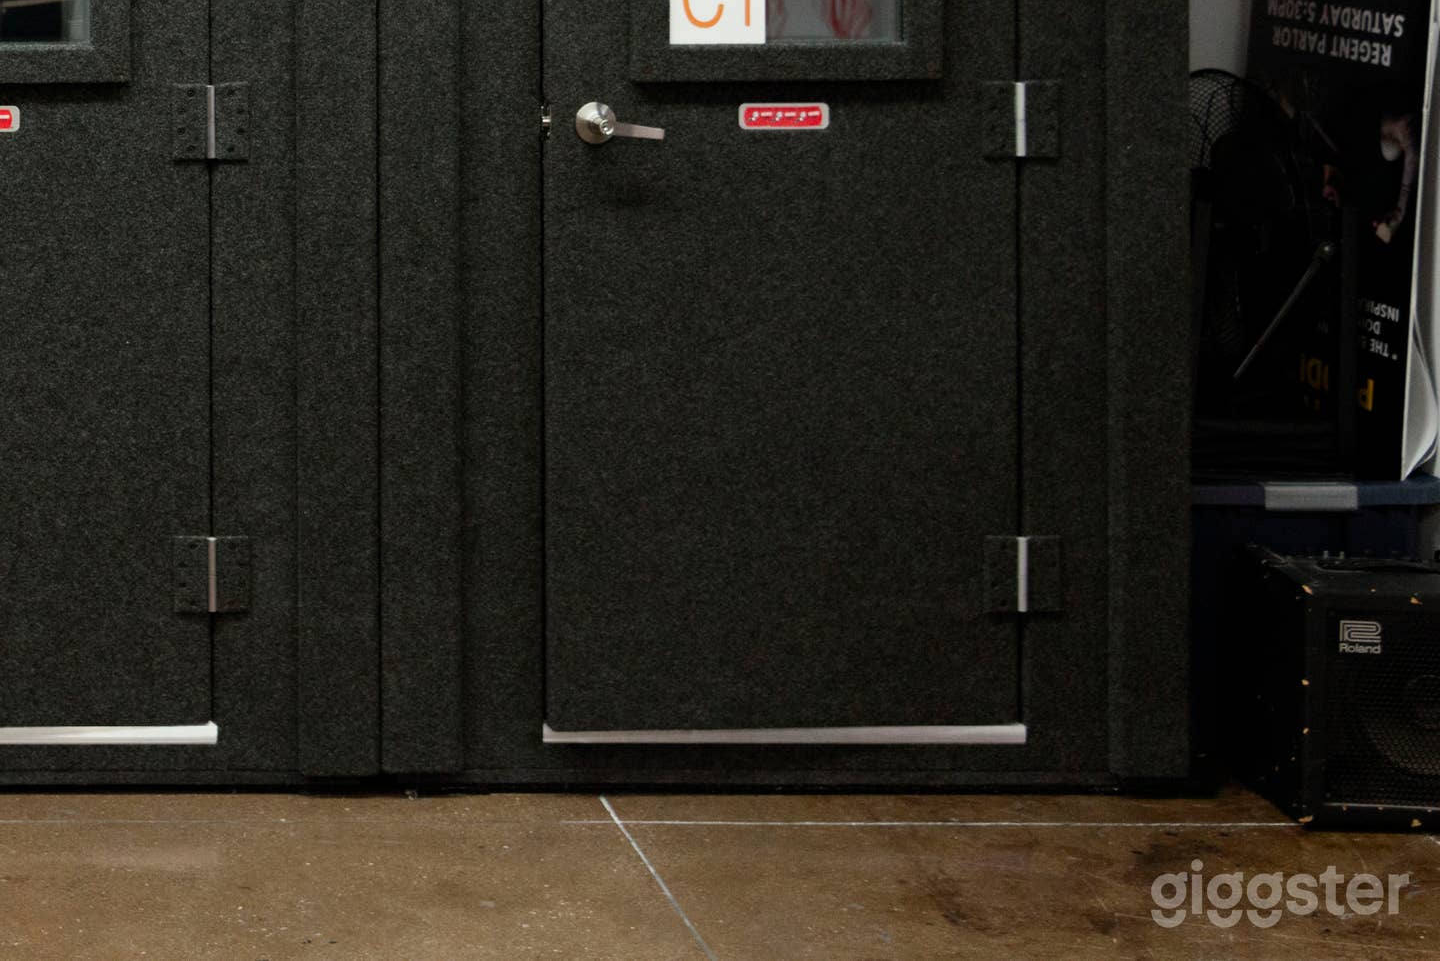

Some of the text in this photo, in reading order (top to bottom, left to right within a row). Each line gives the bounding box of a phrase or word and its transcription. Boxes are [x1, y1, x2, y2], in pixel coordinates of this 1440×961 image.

[1319, 2, 1405, 38] SATURDAY
[1272, 25, 1392, 67] REGENT PARLOR
[1339, 642, 1382, 655] Roland
